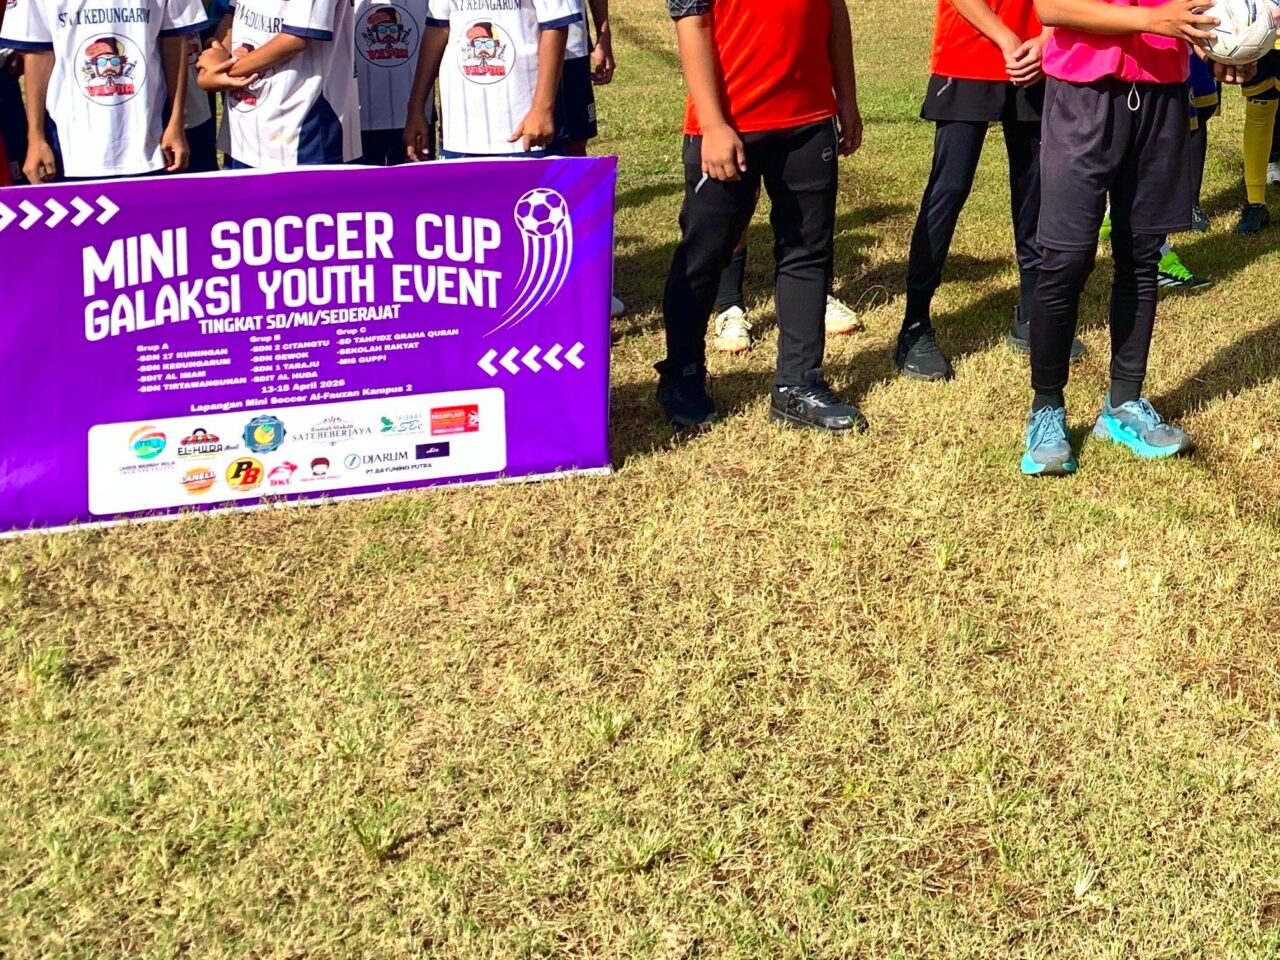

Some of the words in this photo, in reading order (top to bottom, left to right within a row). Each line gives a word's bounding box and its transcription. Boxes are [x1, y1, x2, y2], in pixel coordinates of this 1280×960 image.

[82, 226, 188, 298] MINI
[210, 211, 394, 270] SOCCER
[415, 212, 501, 264] CUP
[84, 273, 241, 342] GALAKSI
[257, 264, 375, 310] YOUTH
[392, 264, 502, 309] EVENT
[198, 315, 264, 335] TINGKAT
[266, 304, 401, 330] SD/MI/SEDERAJAT
[336, 327, 358, 336] Grup
[359, 326, 367, 334] C
[336, 337, 352, 346] -SD
[353, 334, 393, 344] TAHFIDZ
[394, 331, 426, 341] GRAHA
[427, 328, 460, 338] QURAN
[249, 335, 272, 343] Grup
[249, 344, 273, 353] -SDN
[282, 339, 330, 350] CITANGTU
[136, 344, 160, 352] Grup
[161, 342, 169, 350] A
[336, 345, 382, 356] -SEKOLAH
[384, 342, 420, 351] RAKYAT
[136, 354, 160, 362] -SDN
[162, 352, 174, 360] 17
[176, 348, 229, 359] KUNINGAN
[249, 354, 273, 363] -SDN
[274, 351, 309, 361] GEWOK
[358, 355, 387, 364] GUPPI
[136, 364, 161, 372] -SDN
[162, 358, 232, 370] KEDUNGARUM
[250, 365, 273, 373] -SDN
[282, 360, 320, 370] TARAJU
[137, 374, 163, 383] -SDIT
[179, 370, 207, 379] IMAM
[250, 374, 275, 383] -SDIT
[291, 371, 318, 380] HUDA
[137, 384, 161, 393] -SDN
[162, 377, 248, 391] TIRTAWANGUNAN
[261, 384, 290, 394] 13-15
[292, 381, 317, 392] April
[319, 379, 346, 388] 2026
[190, 400, 243, 413] Lapangan
[245, 397, 268, 407] Mini
[270, 394, 307, 405] Soccer
[310, 390, 360, 401] Al-Fauzan
[362, 386, 404, 396] Kampus
[405, 384, 413, 392] 2
[177, 444, 223, 456] EL-HUDA
[362, 451, 408, 465] DJARUM
[411, 462, 433, 471] PUTRA
